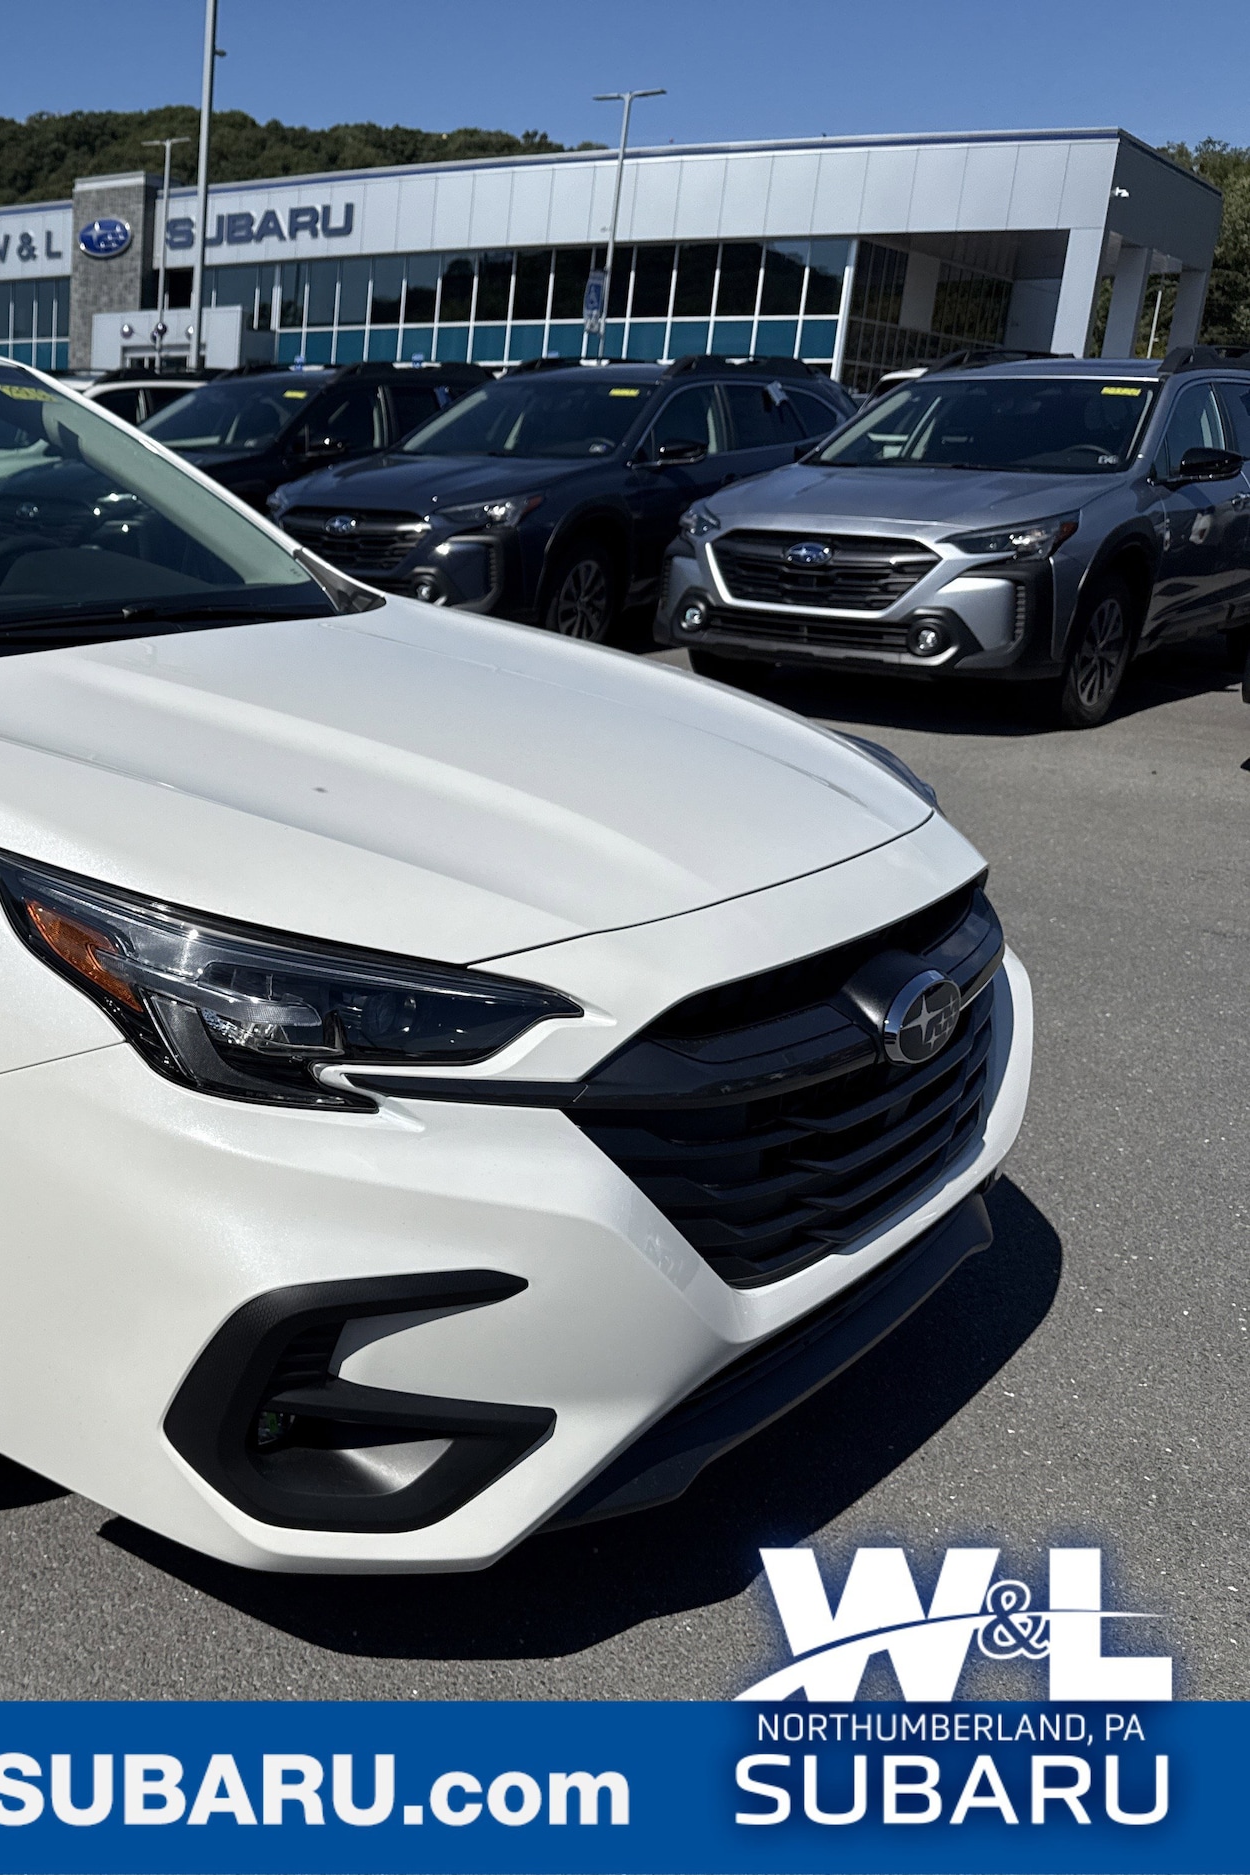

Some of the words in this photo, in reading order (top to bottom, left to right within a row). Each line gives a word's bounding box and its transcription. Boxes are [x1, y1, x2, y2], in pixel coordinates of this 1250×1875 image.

[17, 231, 38, 262] &
[45, 229, 63, 259] L
[166, 203, 355, 250] SUBARU
